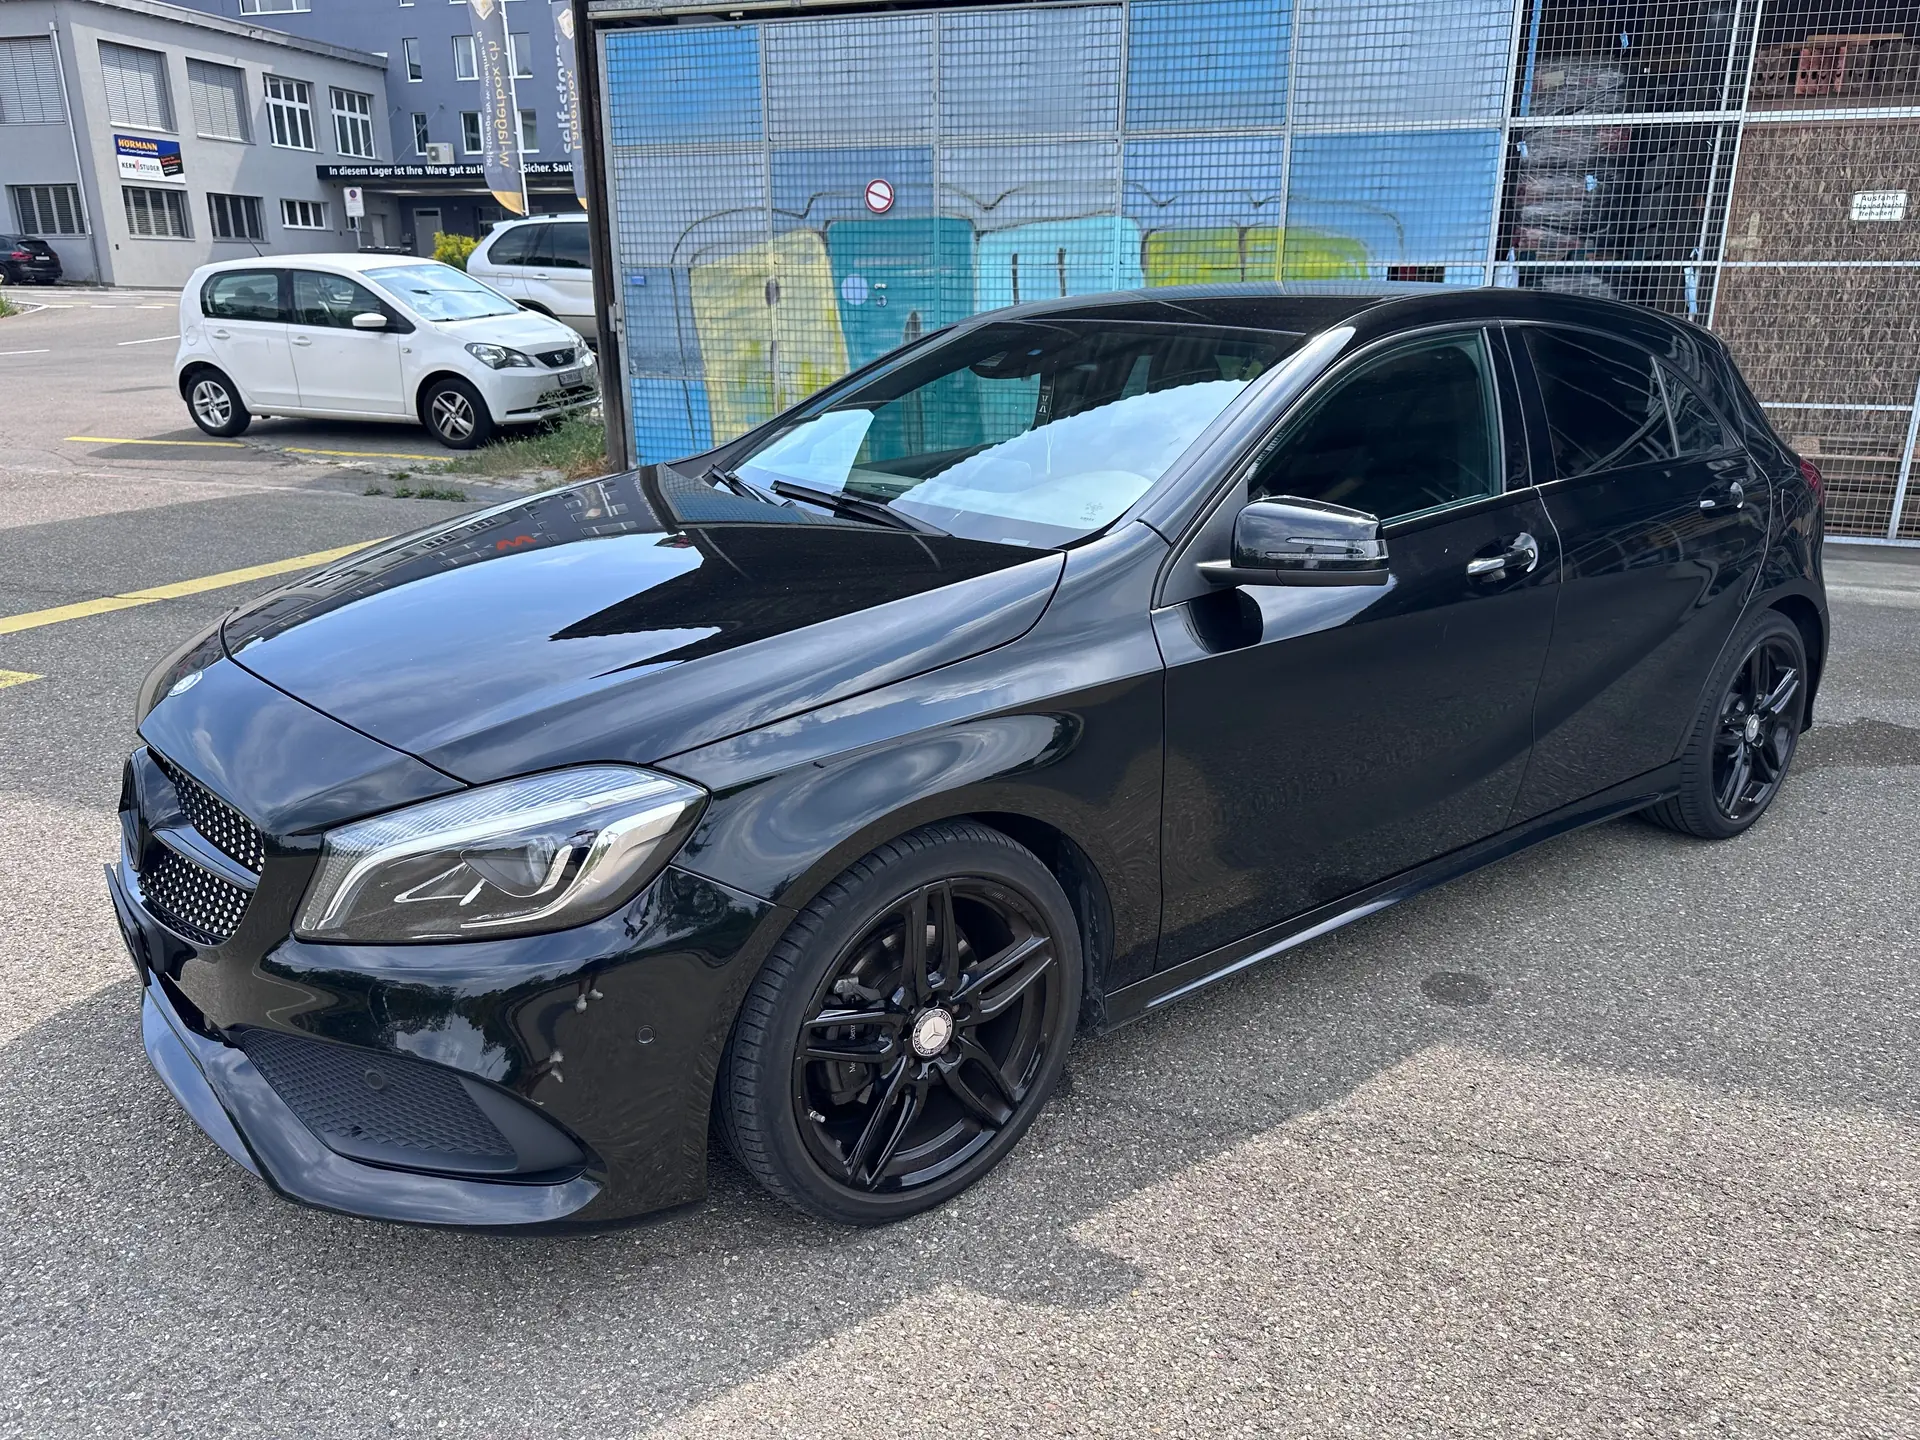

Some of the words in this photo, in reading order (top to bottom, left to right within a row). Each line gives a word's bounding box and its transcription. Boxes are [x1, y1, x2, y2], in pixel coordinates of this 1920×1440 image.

[121, 161, 136, 169] KERN
[139, 163, 160, 171] STUDER
[329, 167, 338, 175] In
[339, 166, 368, 175] diesem
[369, 166, 393, 177] Lager
[394, 166, 405, 175] ist
[406, 166, 423, 175] Ihre
[425, 166, 447, 175] Ware
[449, 167, 464, 177] gut
[523, 163, 551, 174] Sicher.
[1861, 194, 1899, 202] Ausfahrt
